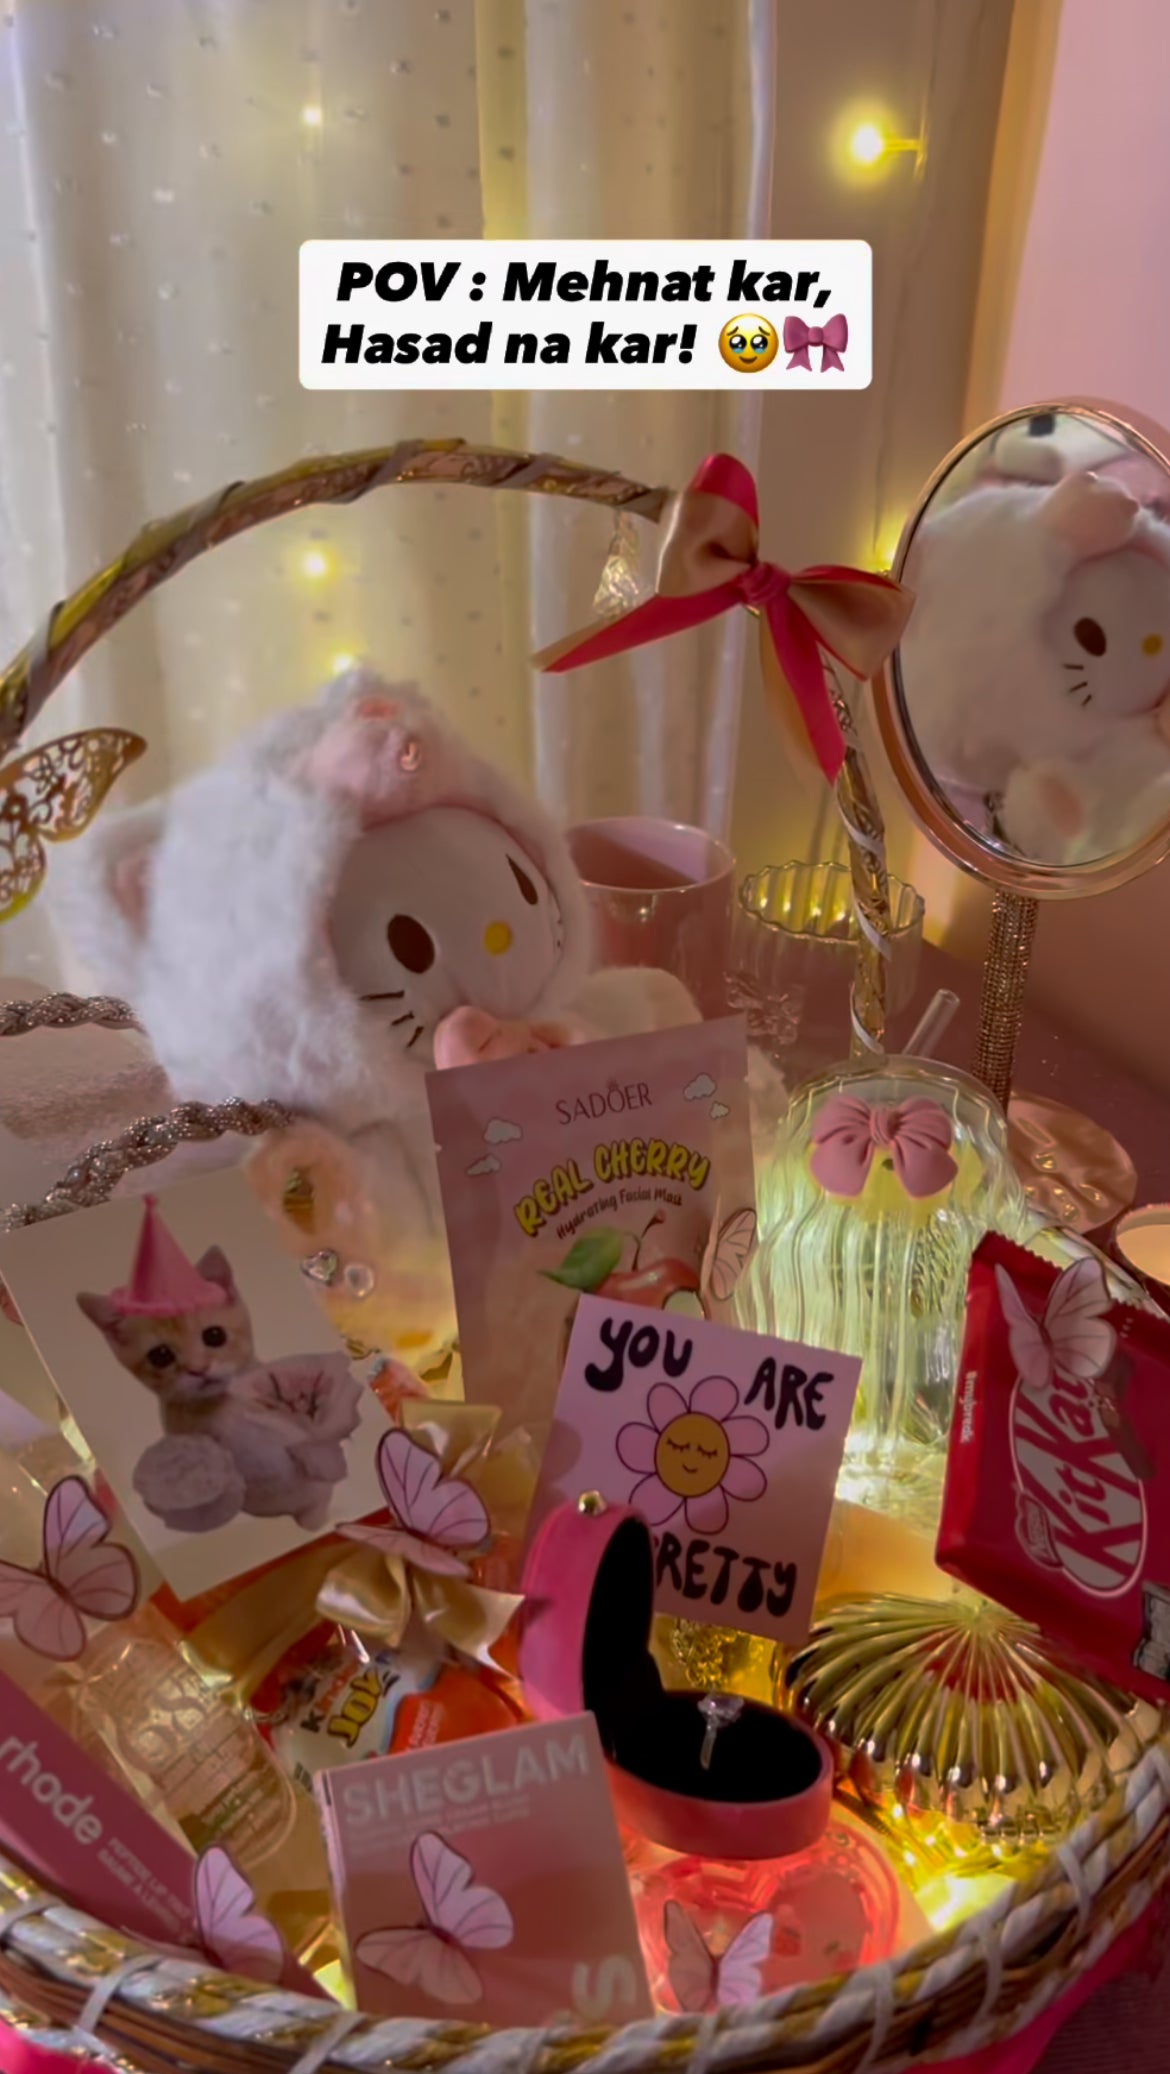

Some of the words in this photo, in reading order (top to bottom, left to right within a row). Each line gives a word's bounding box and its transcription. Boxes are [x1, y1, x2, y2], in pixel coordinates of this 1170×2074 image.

[513, 1159, 594, 1238] REAL
[593, 1137, 710, 1192] CHERRY
[556, 1192, 618, 1239] Hydrating
[585, 1317, 693, 1393] YOU
[744, 1356, 835, 1431] ARE
[655, 1531, 797, 1618] RETTY
[0, 1735, 103, 1845] rhode
[344, 1733, 590, 1827] SHEGLAM
